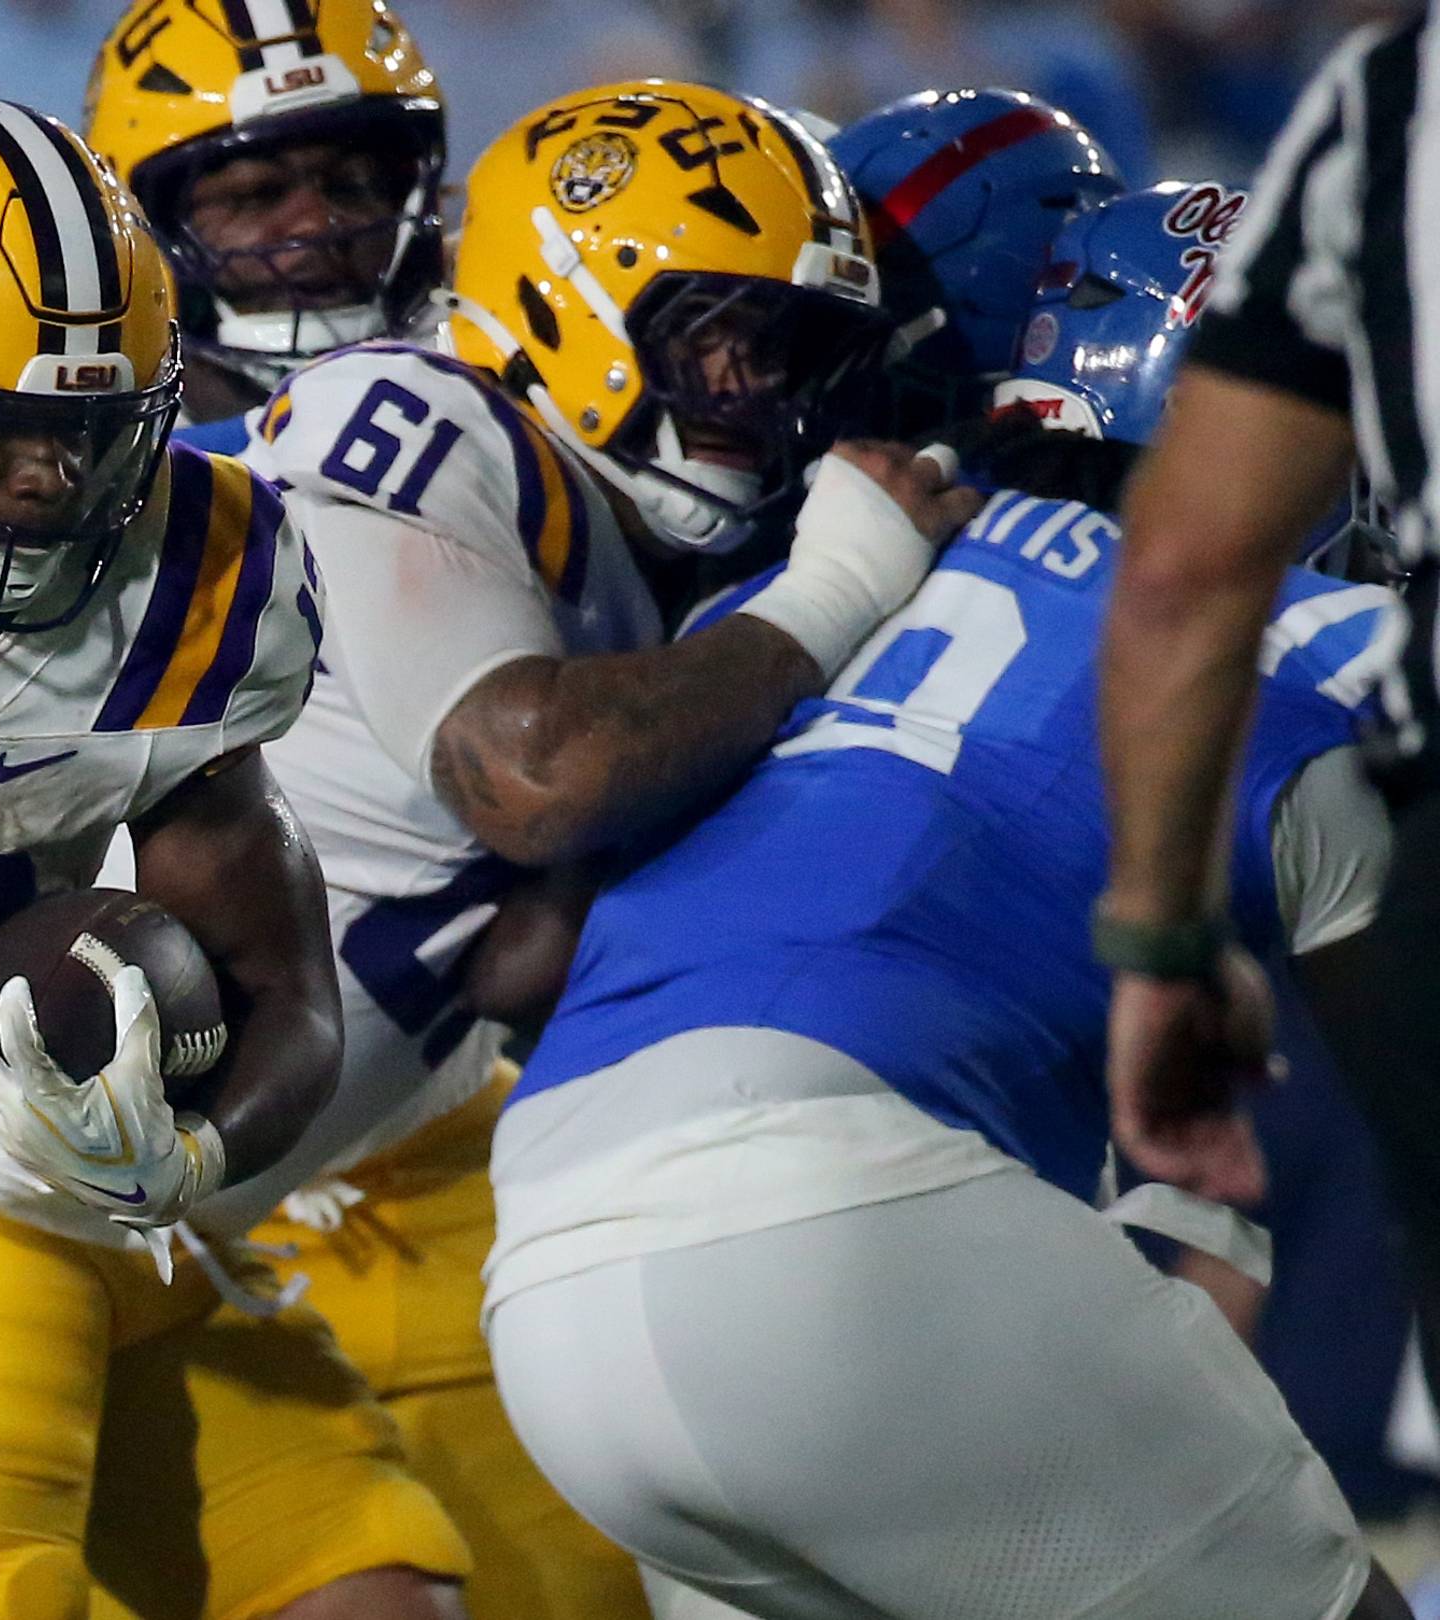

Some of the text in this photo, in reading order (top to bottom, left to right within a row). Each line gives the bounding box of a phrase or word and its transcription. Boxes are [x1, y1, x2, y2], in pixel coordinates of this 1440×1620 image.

[264, 66, 324, 95] LSU
[56, 365, 118, 392] LSU
[320, 378, 464, 517] 61
